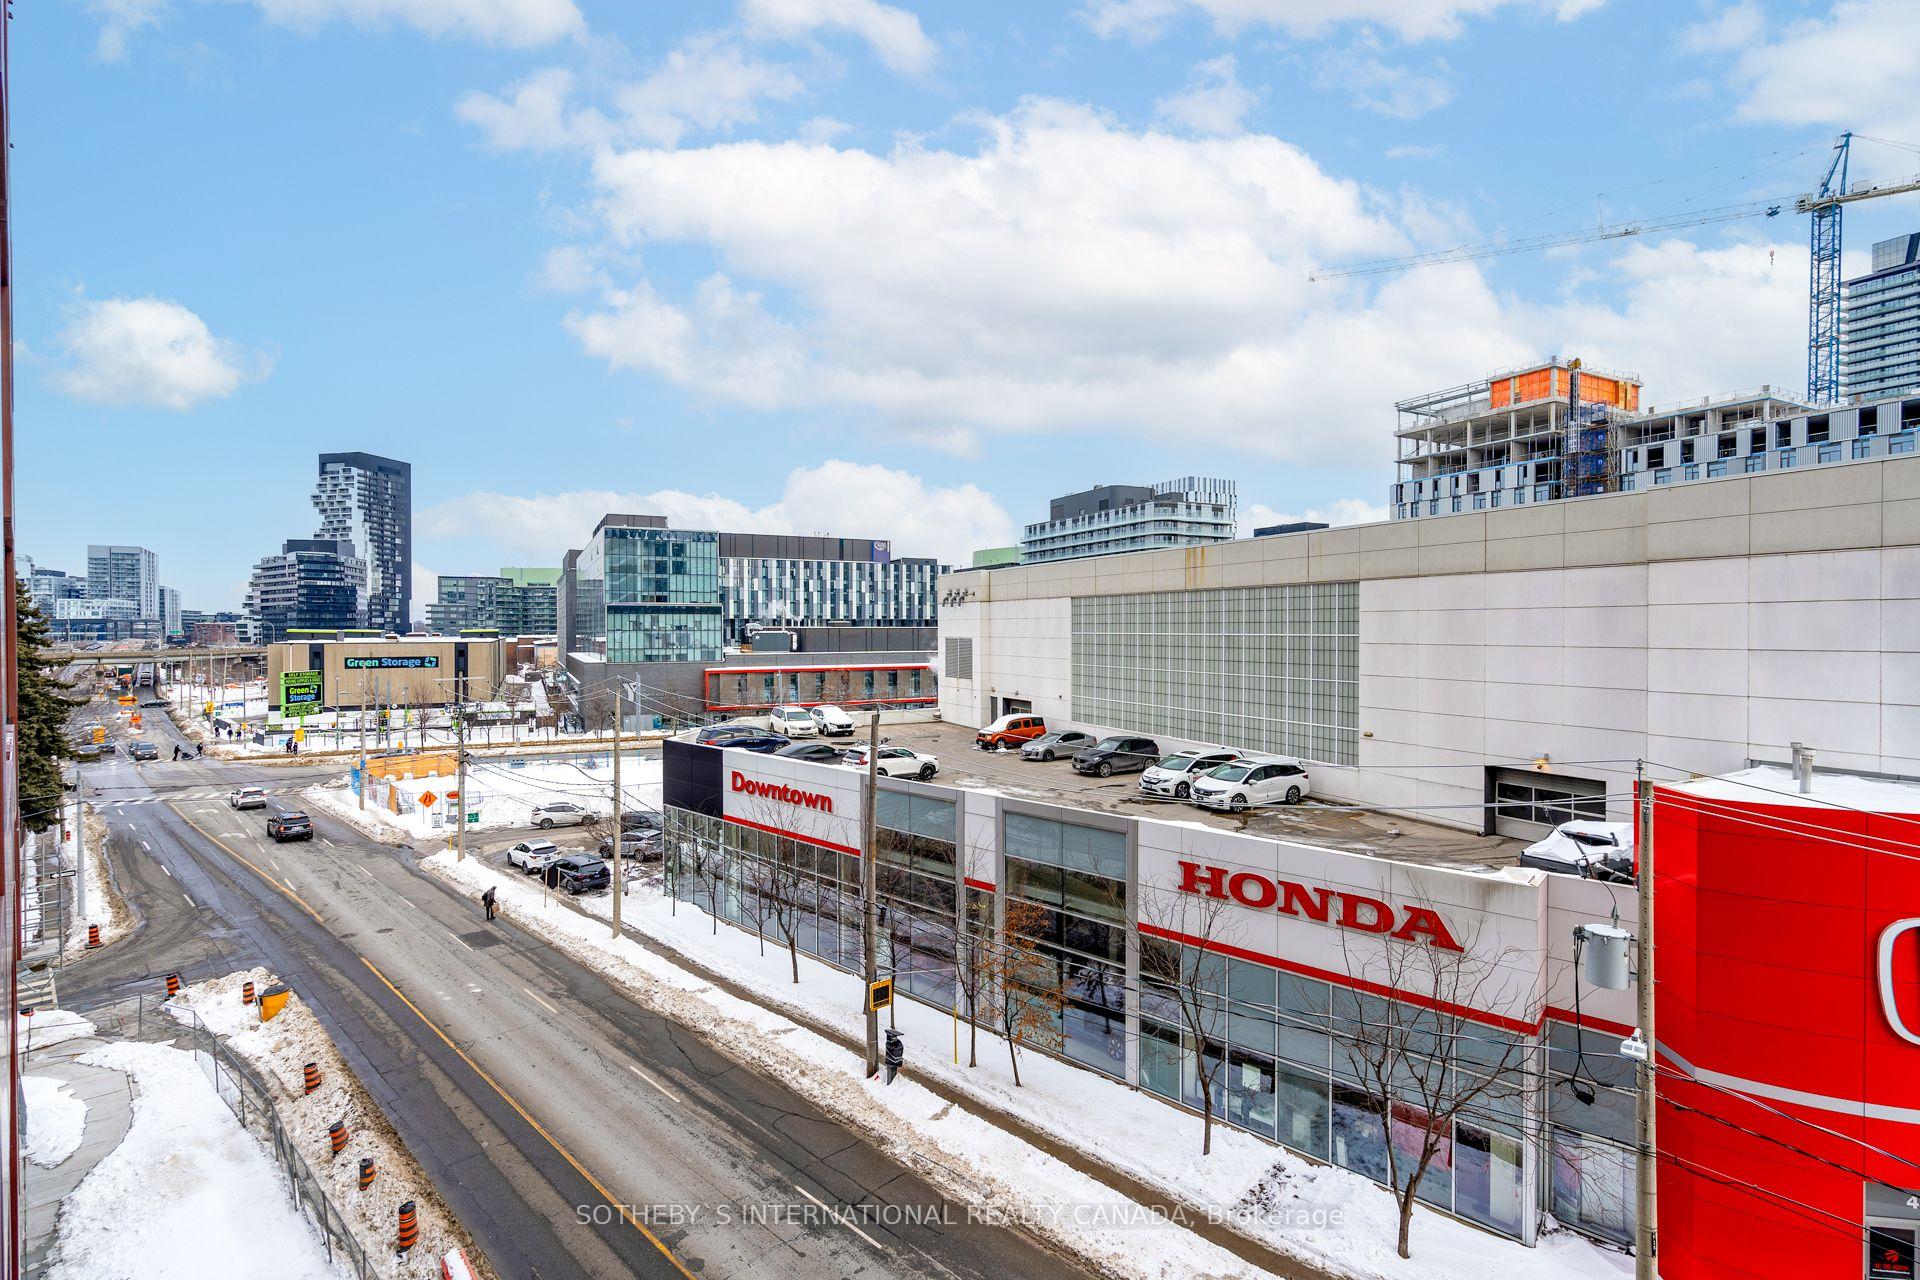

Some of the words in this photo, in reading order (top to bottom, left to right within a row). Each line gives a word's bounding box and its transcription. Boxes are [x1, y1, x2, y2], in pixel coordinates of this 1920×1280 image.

[347, 658, 379, 667] Green
[381, 657, 421, 668] Storage
[290, 687, 309, 695] Green
[290, 694, 315, 702] Storage
[731, 770, 832, 813] Downtown
[1178, 860, 1464, 953] HONDA
